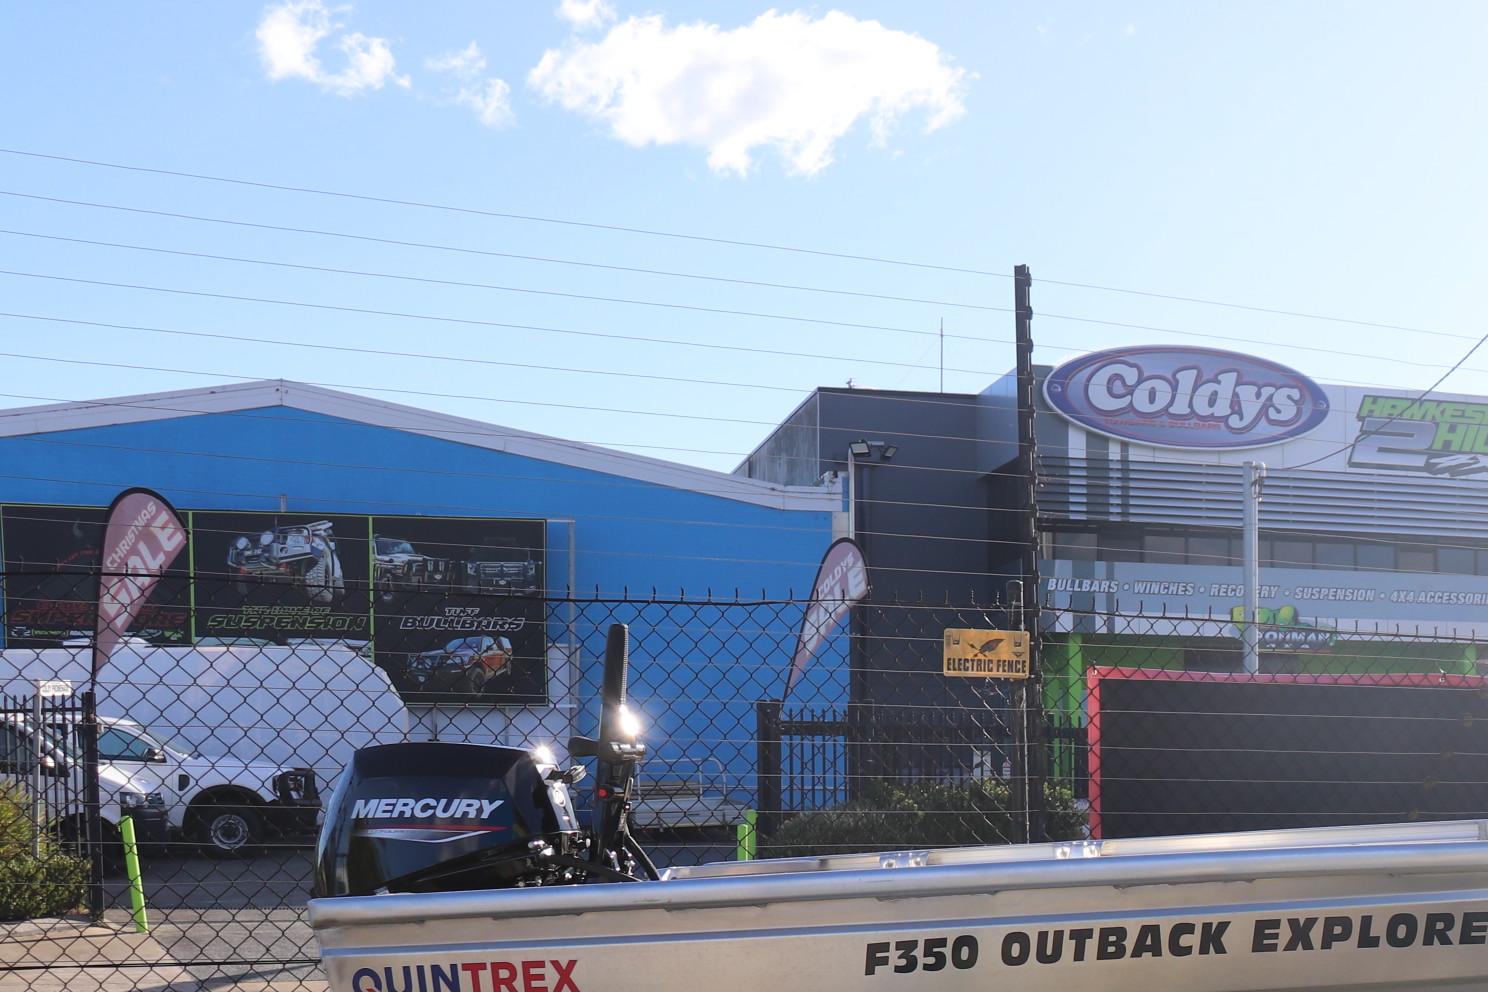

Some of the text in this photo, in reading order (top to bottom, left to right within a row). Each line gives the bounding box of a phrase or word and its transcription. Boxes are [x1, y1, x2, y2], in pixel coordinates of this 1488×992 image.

[1087, 362, 1301, 429] Coldys
[1349, 417, 1437, 467] 2
[106, 501, 157, 570] CHRISTMAS
[1047, 578, 1118, 593] BULLBARS
[1132, 580, 1194, 596] WINCHES
[1209, 583, 1279, 599] RECOERY
[1294, 587, 1376, 602] SUSPENSION
[1390, 590, 1415, 603] 4X4
[207, 614, 367, 631] SUSPENSION
[400, 616, 526, 631] BULLBARS
[947, 658, 1027, 673] ELECTRIC FENCE
[350, 798, 505, 820] MERCURY
[865, 936, 979, 976] F350
[1001, 920, 1230, 967] OUTBACK
